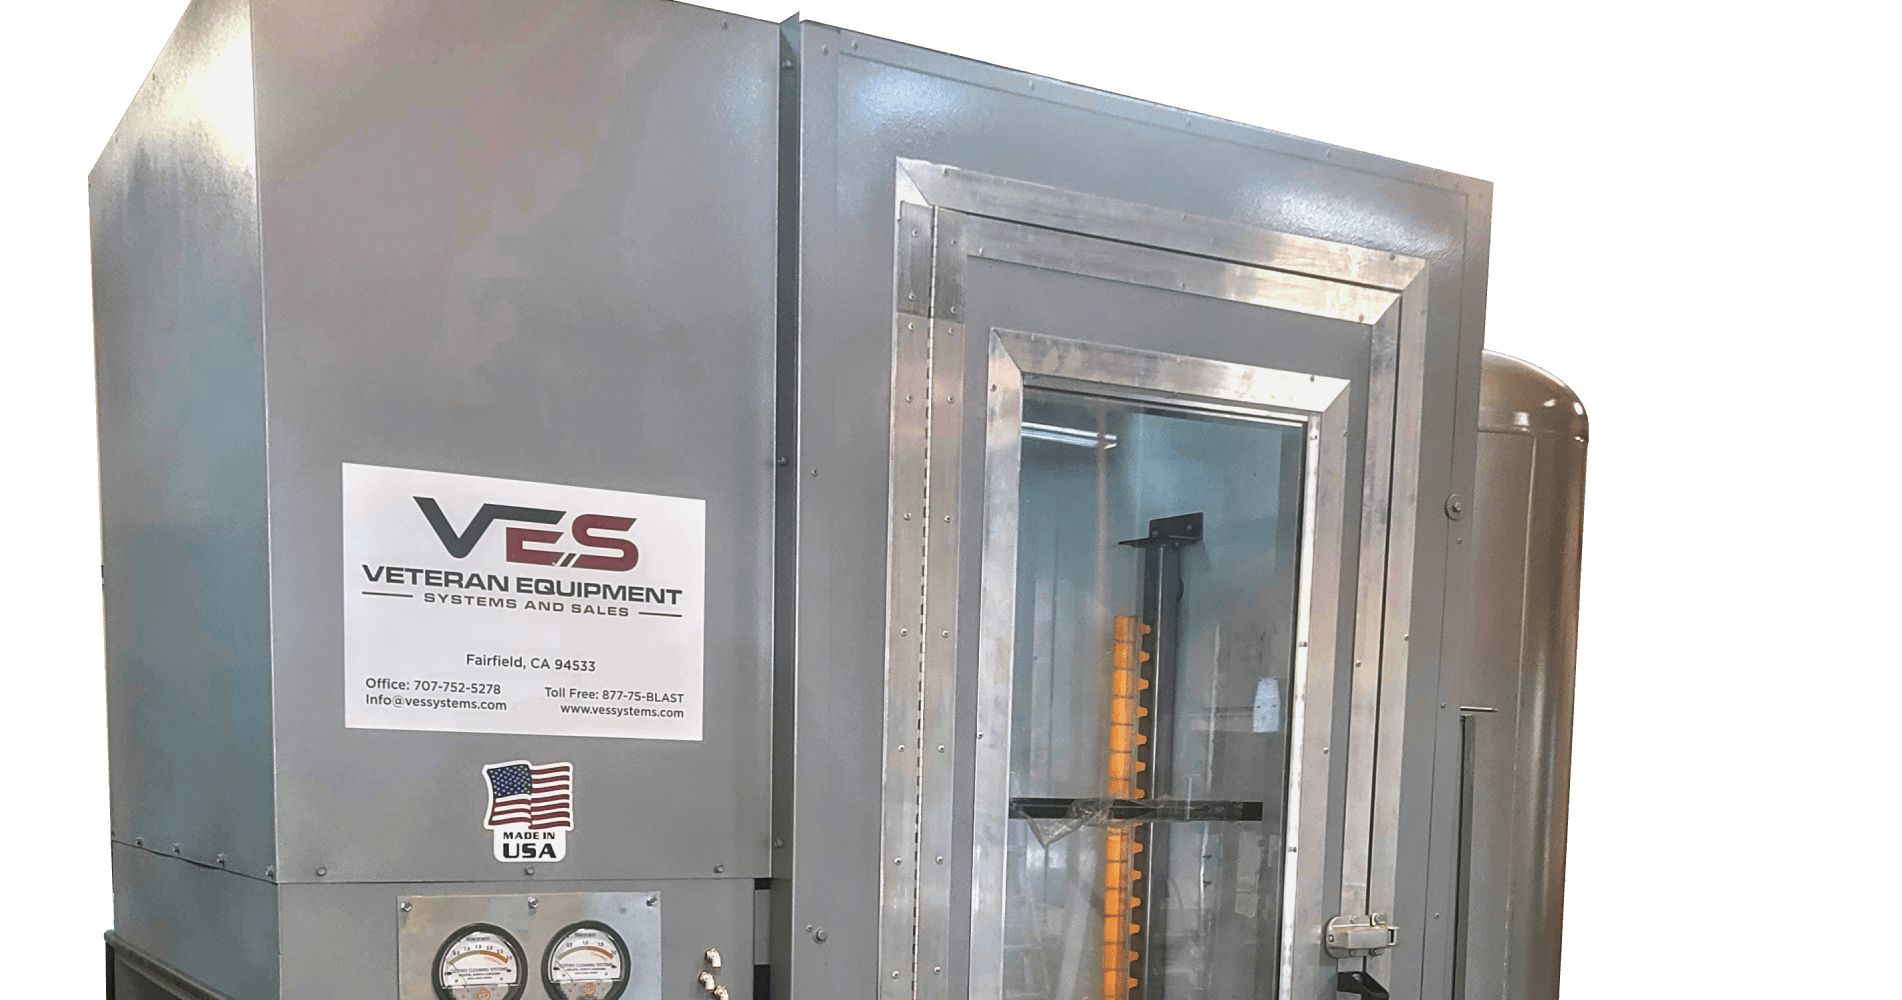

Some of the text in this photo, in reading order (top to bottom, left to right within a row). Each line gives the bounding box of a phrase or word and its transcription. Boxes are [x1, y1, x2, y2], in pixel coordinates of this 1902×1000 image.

[412, 496, 639, 572] VES
[361, 564, 683, 605] VETERAN EQUIPMENT
[424, 592, 629, 617] SYSTEMS AND SALES
[466, 654, 596, 672] Fairfield, CA 94533
[365, 678, 501, 695] Office: 707-752-5278
[365, 694, 507, 710] Info@vessystems.com
[544, 687, 685, 703] Toll Free: 877-75-BLAST
[560, 705, 684, 718] www.vessystems.com
[503, 831, 555, 840] MADE IN
[503, 843, 557, 858] USA
